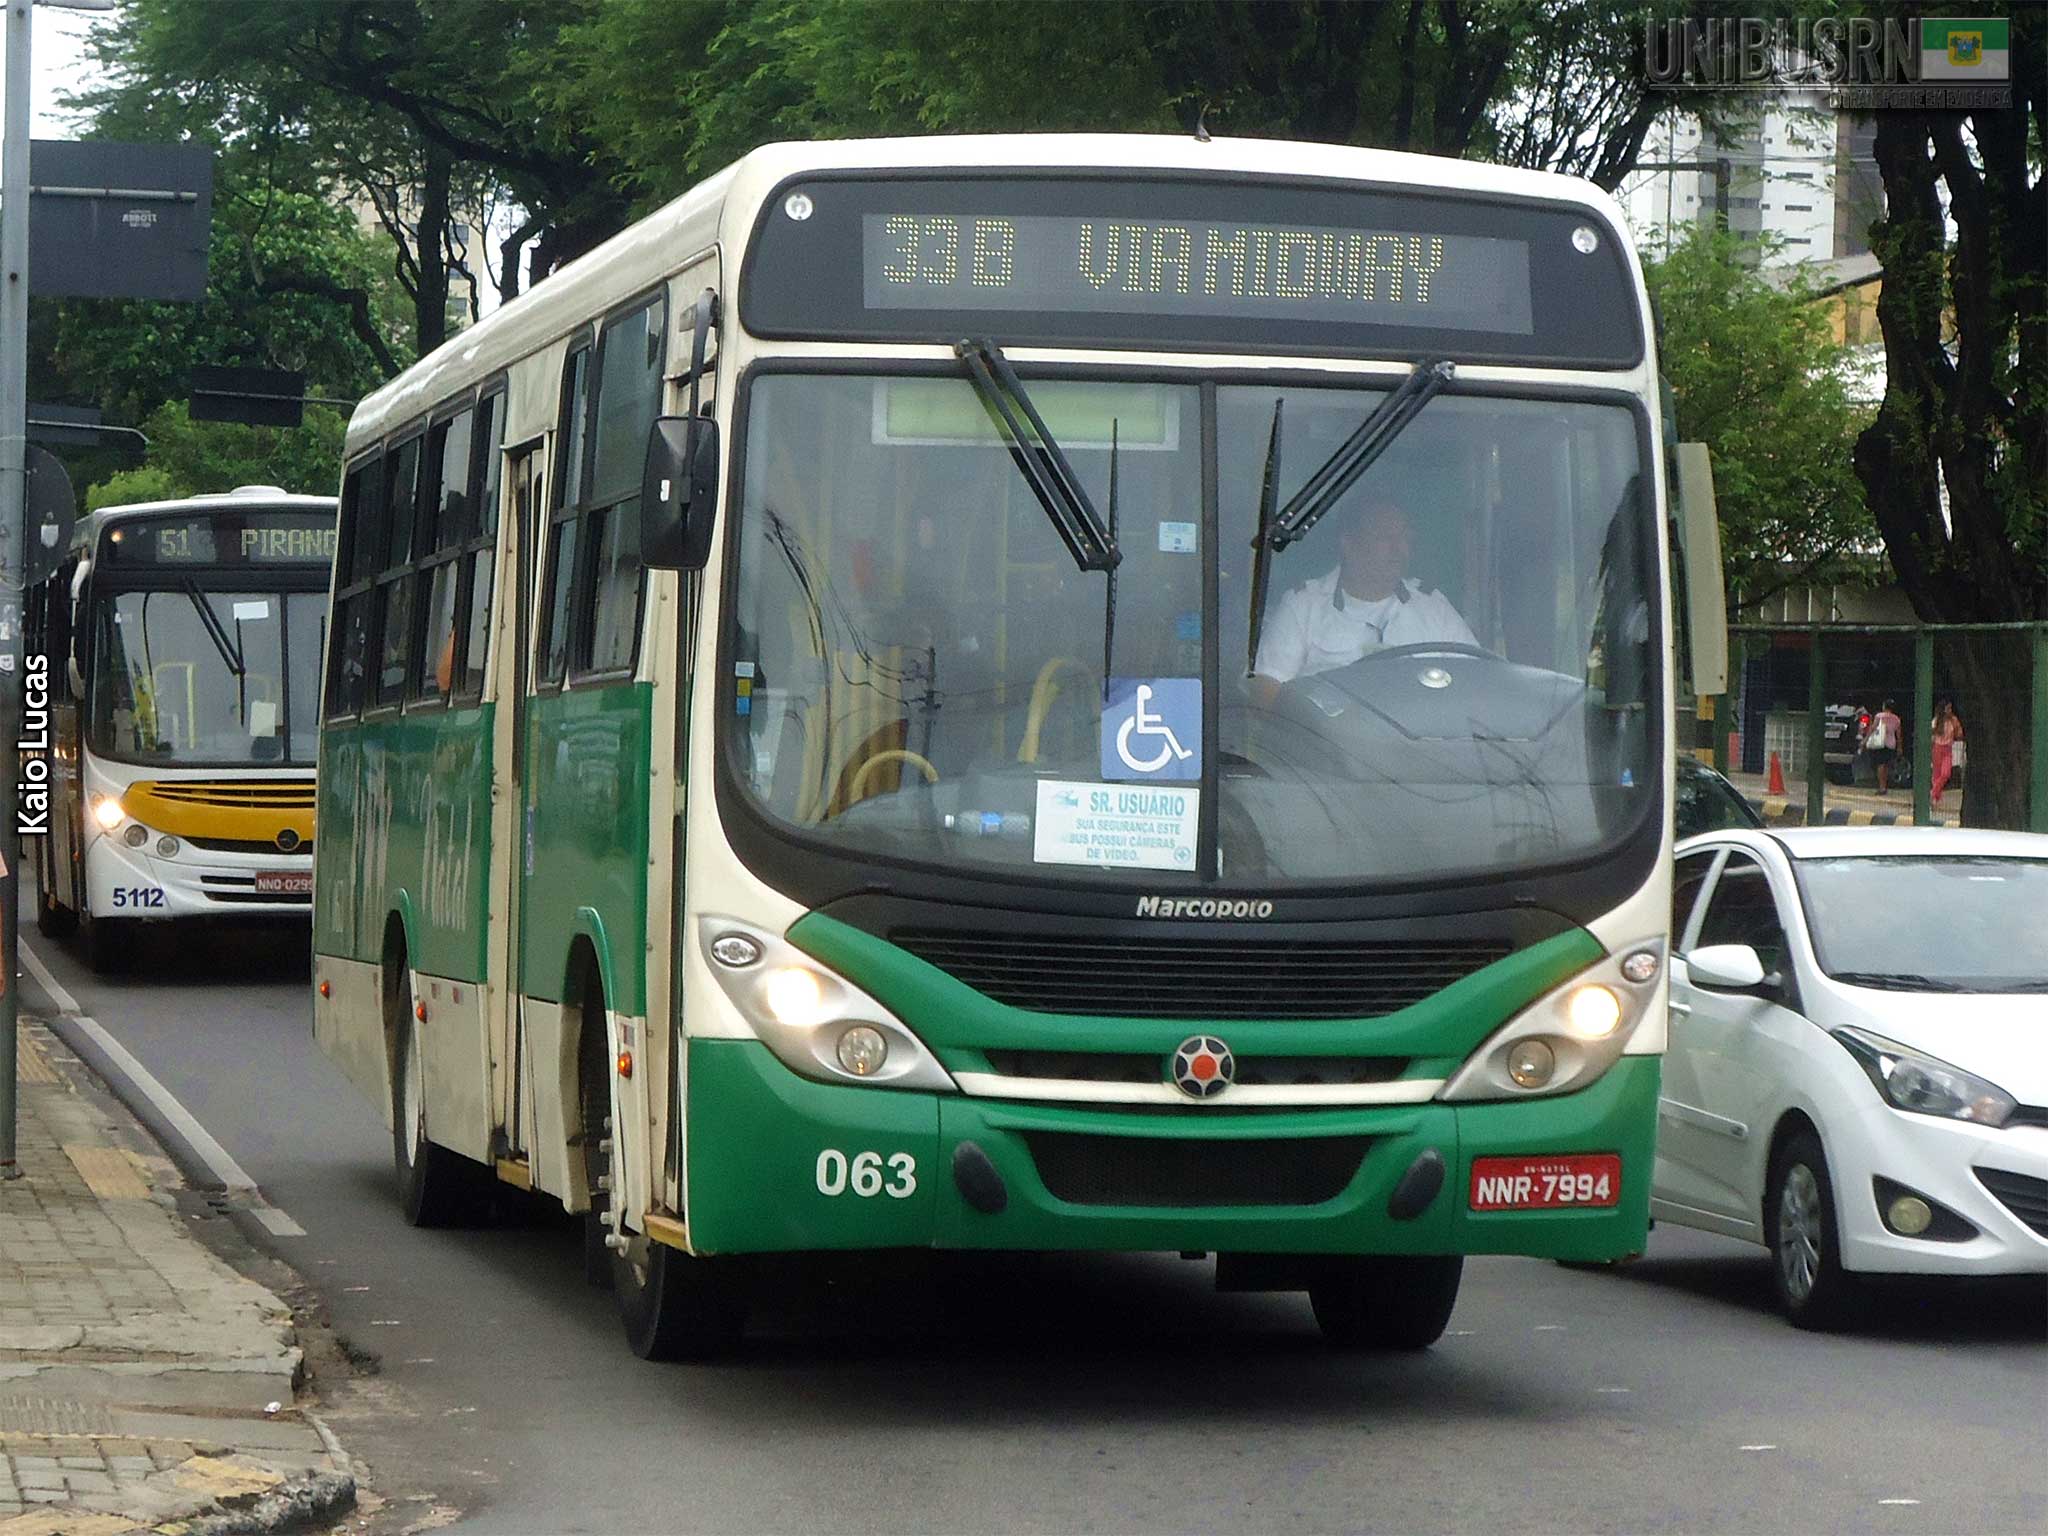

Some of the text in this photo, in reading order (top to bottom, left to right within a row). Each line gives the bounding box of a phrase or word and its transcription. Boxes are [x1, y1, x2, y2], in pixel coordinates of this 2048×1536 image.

[883, 216, 1445, 303] 33 B VIA MIDWAY
[160, 528, 192, 557] 51
[1090, 789, 1185, 816] SR. USUÁRIO
[1076, 818, 1095, 830] SUA
[1156, 822, 1181, 835] ESTE
[1091, 833, 1127, 846] POSSUI
[1086, 847, 1101, 858] DE
[113, 887, 164, 907] 5112
[1136, 896, 1273, 918] Marcopolo
[816, 1149, 917, 1199] 063
